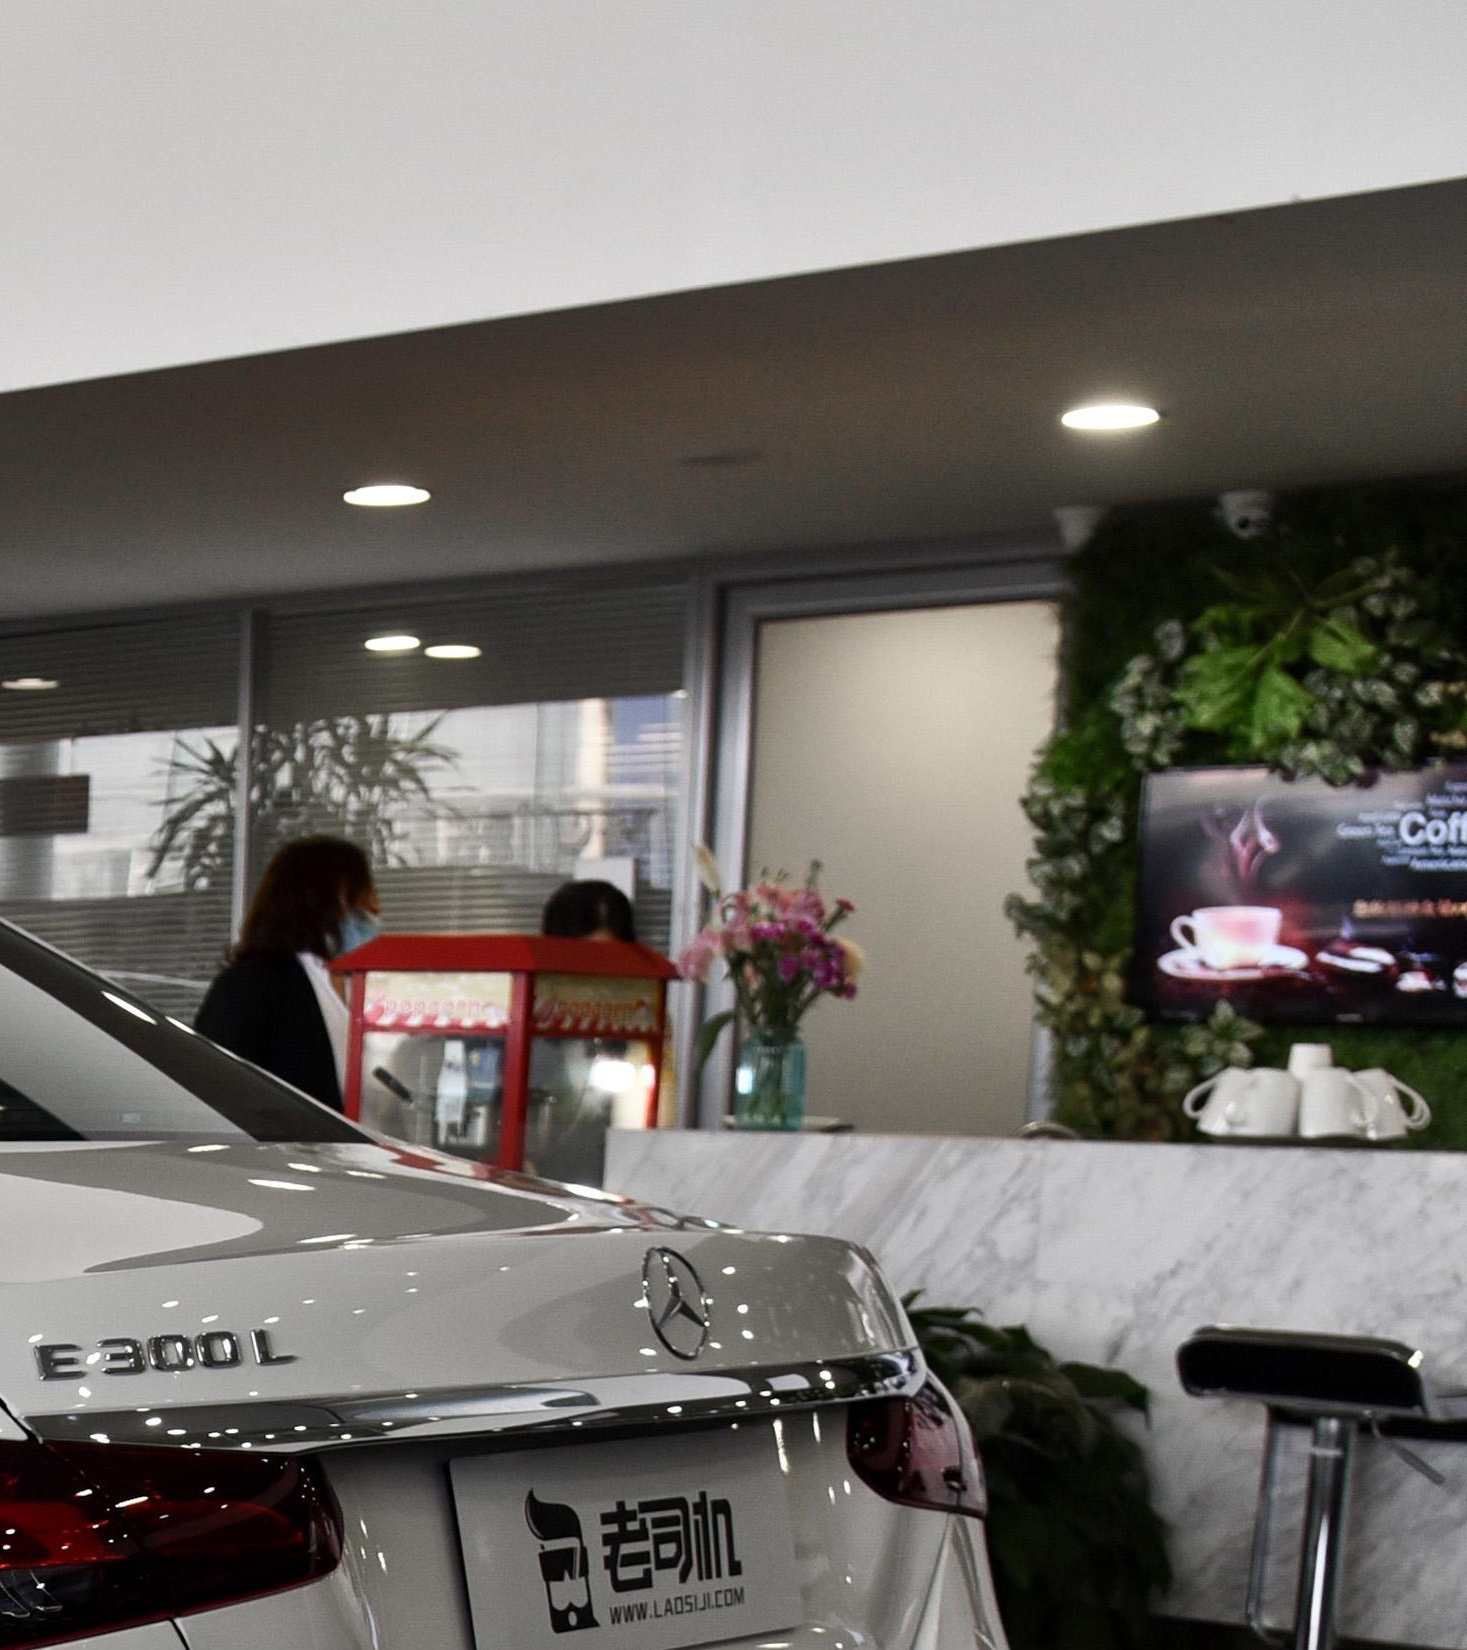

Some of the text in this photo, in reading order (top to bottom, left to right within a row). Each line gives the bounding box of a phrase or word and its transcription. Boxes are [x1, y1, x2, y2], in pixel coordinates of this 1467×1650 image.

[599, 1489, 743, 1594] 老司机
[609, 1586, 745, 1625] WWW.LAOSIJI.COM
